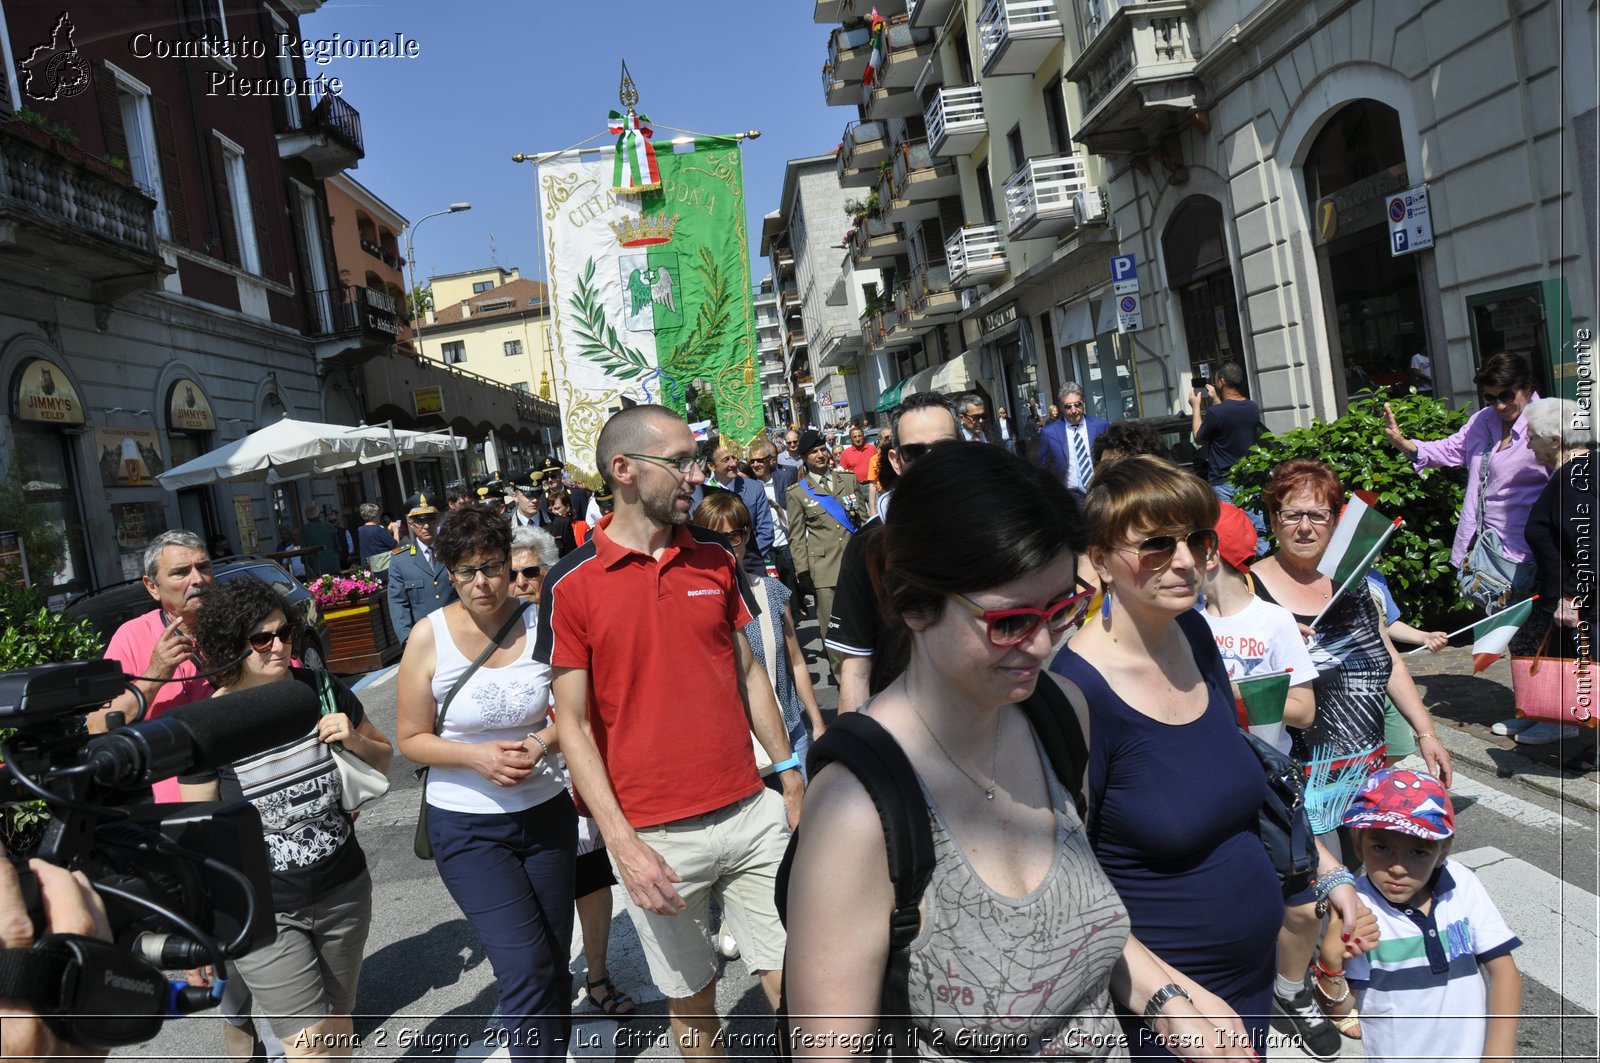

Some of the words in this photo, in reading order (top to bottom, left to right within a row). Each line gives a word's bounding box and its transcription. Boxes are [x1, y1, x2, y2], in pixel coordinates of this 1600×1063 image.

[646, 179, 716, 216] ARONA
[1395, 232, 1405, 250] P
[1114, 257, 1132, 280] P
[28, 395, 72, 412] JIMMY'S
[41, 411, 65, 420] KEILER
[177, 408, 207, 420] JIMMY'S
[1215, 635, 1234, 649] NG
[104, 969, 155, 995] Panasonic
[937, 984, 975, 1006] 978
